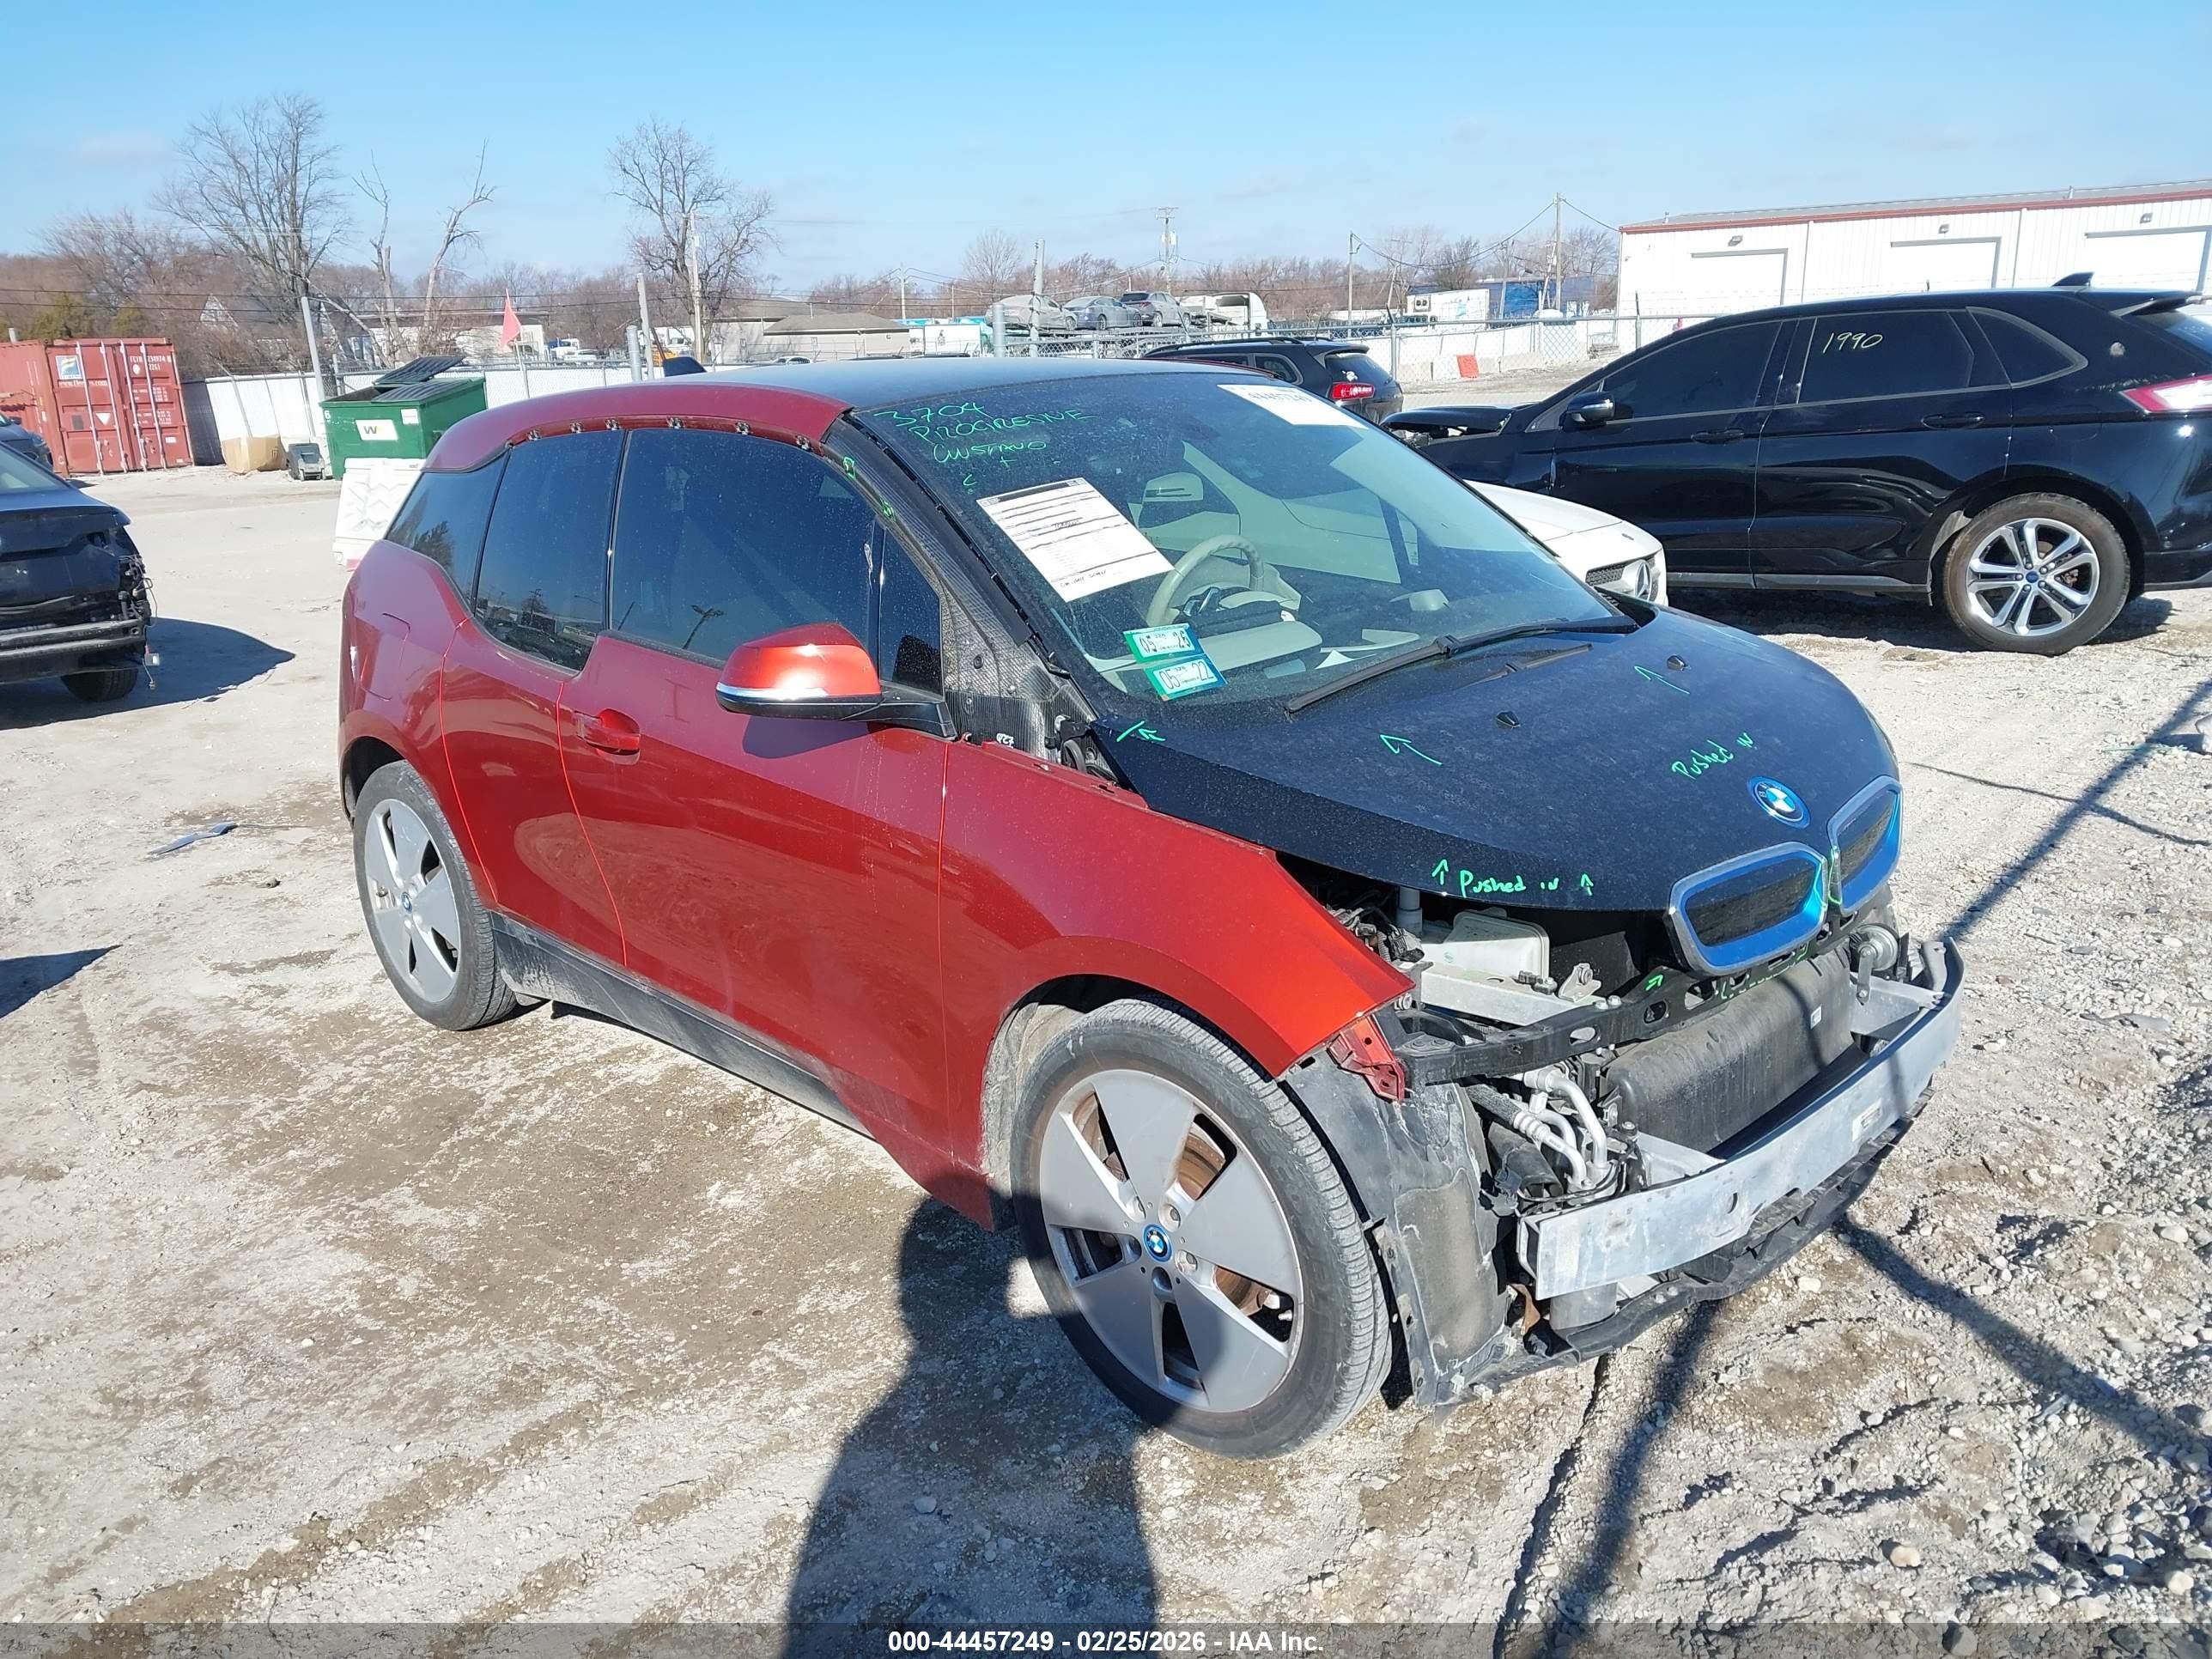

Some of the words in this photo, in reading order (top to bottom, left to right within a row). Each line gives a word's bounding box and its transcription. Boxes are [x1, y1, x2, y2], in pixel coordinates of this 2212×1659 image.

[1822, 331, 1883, 354] 1990
[874, 402, 994, 427] 3704
[1158, 671, 1181, 690] 05
[1191, 660, 1214, 681] 22
[1671, 738, 1735, 781] Pushed
[1460, 869, 1527, 898] Pushed
